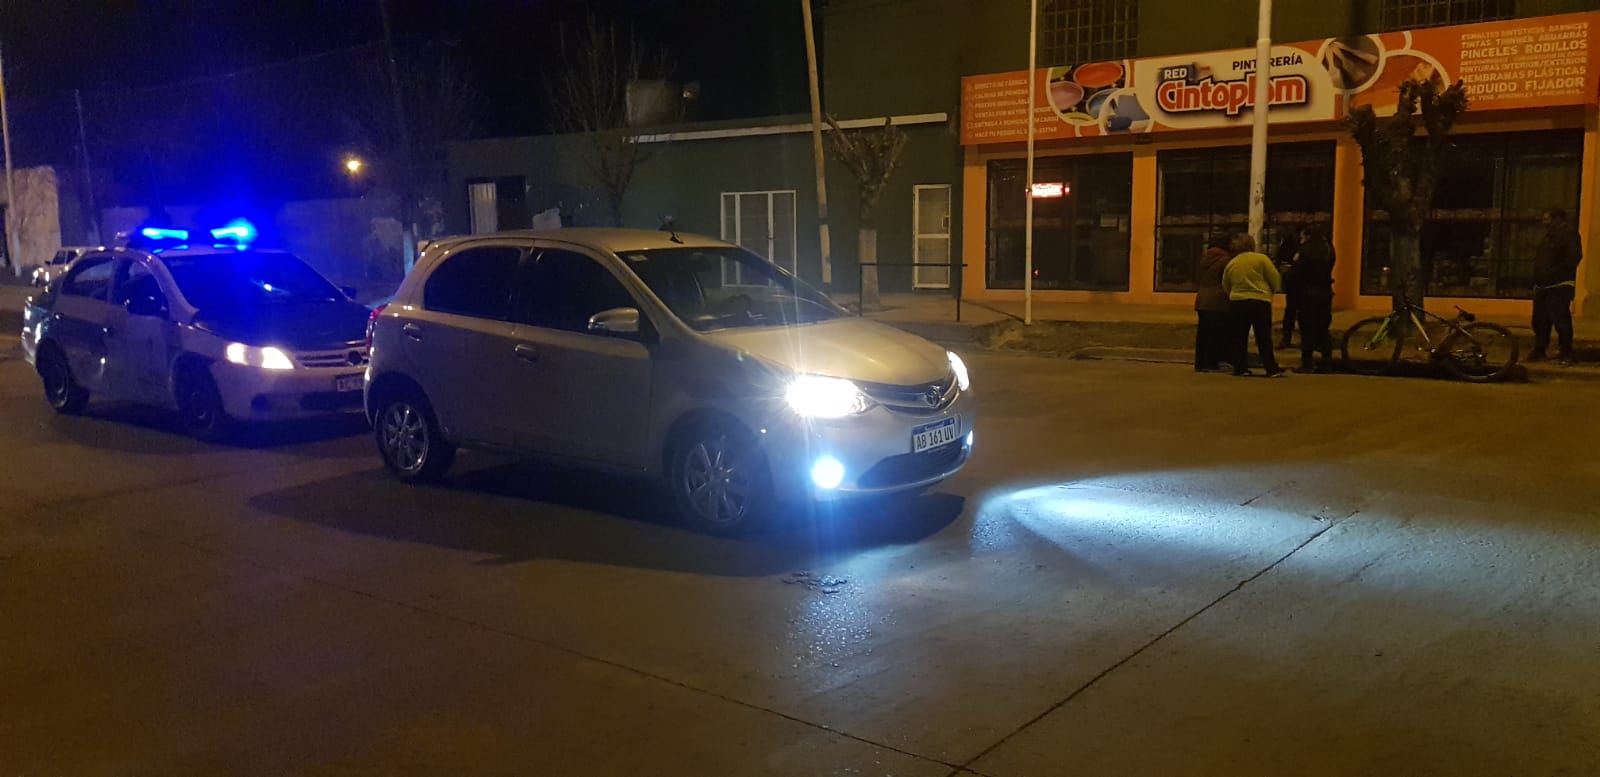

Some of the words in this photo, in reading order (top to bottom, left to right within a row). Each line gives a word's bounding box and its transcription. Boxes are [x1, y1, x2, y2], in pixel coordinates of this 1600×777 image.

[1460, 45, 1518, 59] PINCELES
[1525, 39, 1587, 54] RODILLOS
[1461, 40, 1491, 49] TINTAS
[1232, 53, 1303, 71] PINTRERÍA
[1460, 63, 1500, 73] PINTURAS
[1164, 67, 1188, 79] RED
[1525, 77, 1585, 91] FIJADOR
[1157, 73, 1306, 115] Cintoplm
[917, 434, 926, 450] AB
[929, 430, 943, 446] 161
[944, 425, 954, 440] UV
